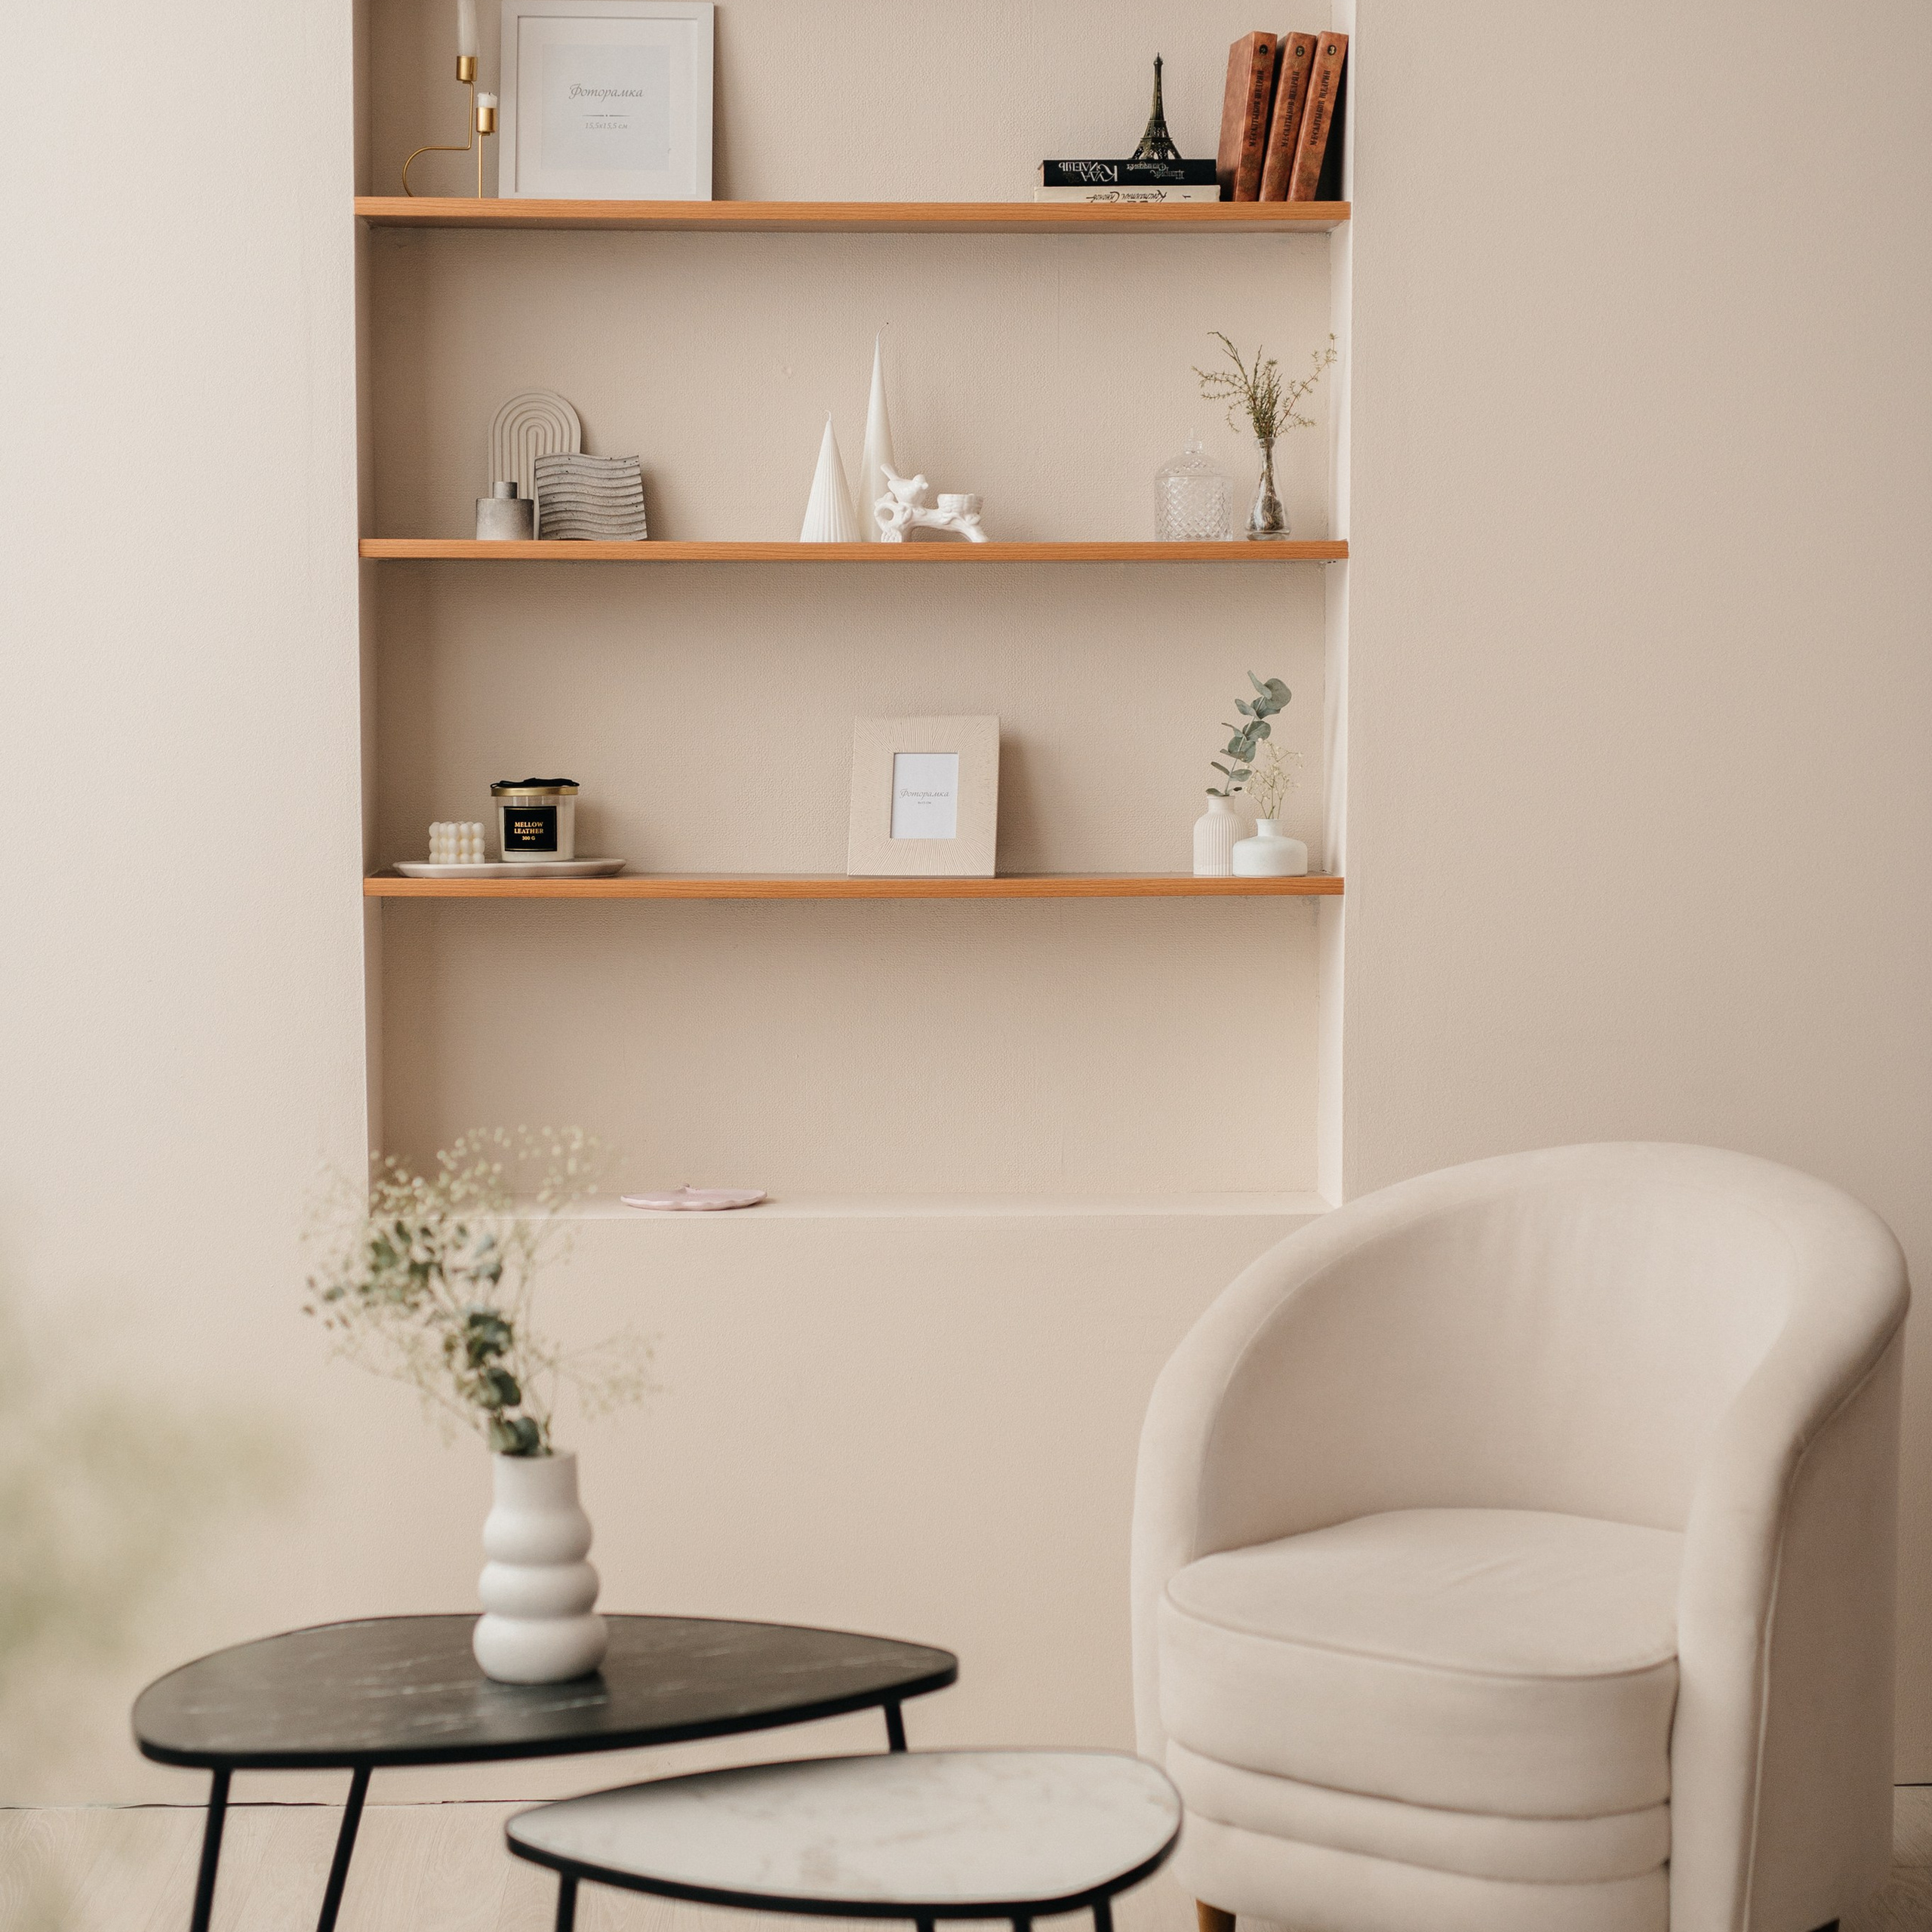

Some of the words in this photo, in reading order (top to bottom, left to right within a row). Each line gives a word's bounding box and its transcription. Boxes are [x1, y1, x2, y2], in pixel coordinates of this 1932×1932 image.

[568, 83, 644, 103] Фоторамка
[1081, 164, 1118, 181] КУДА
[900, 789, 949, 801] Фоторамка
